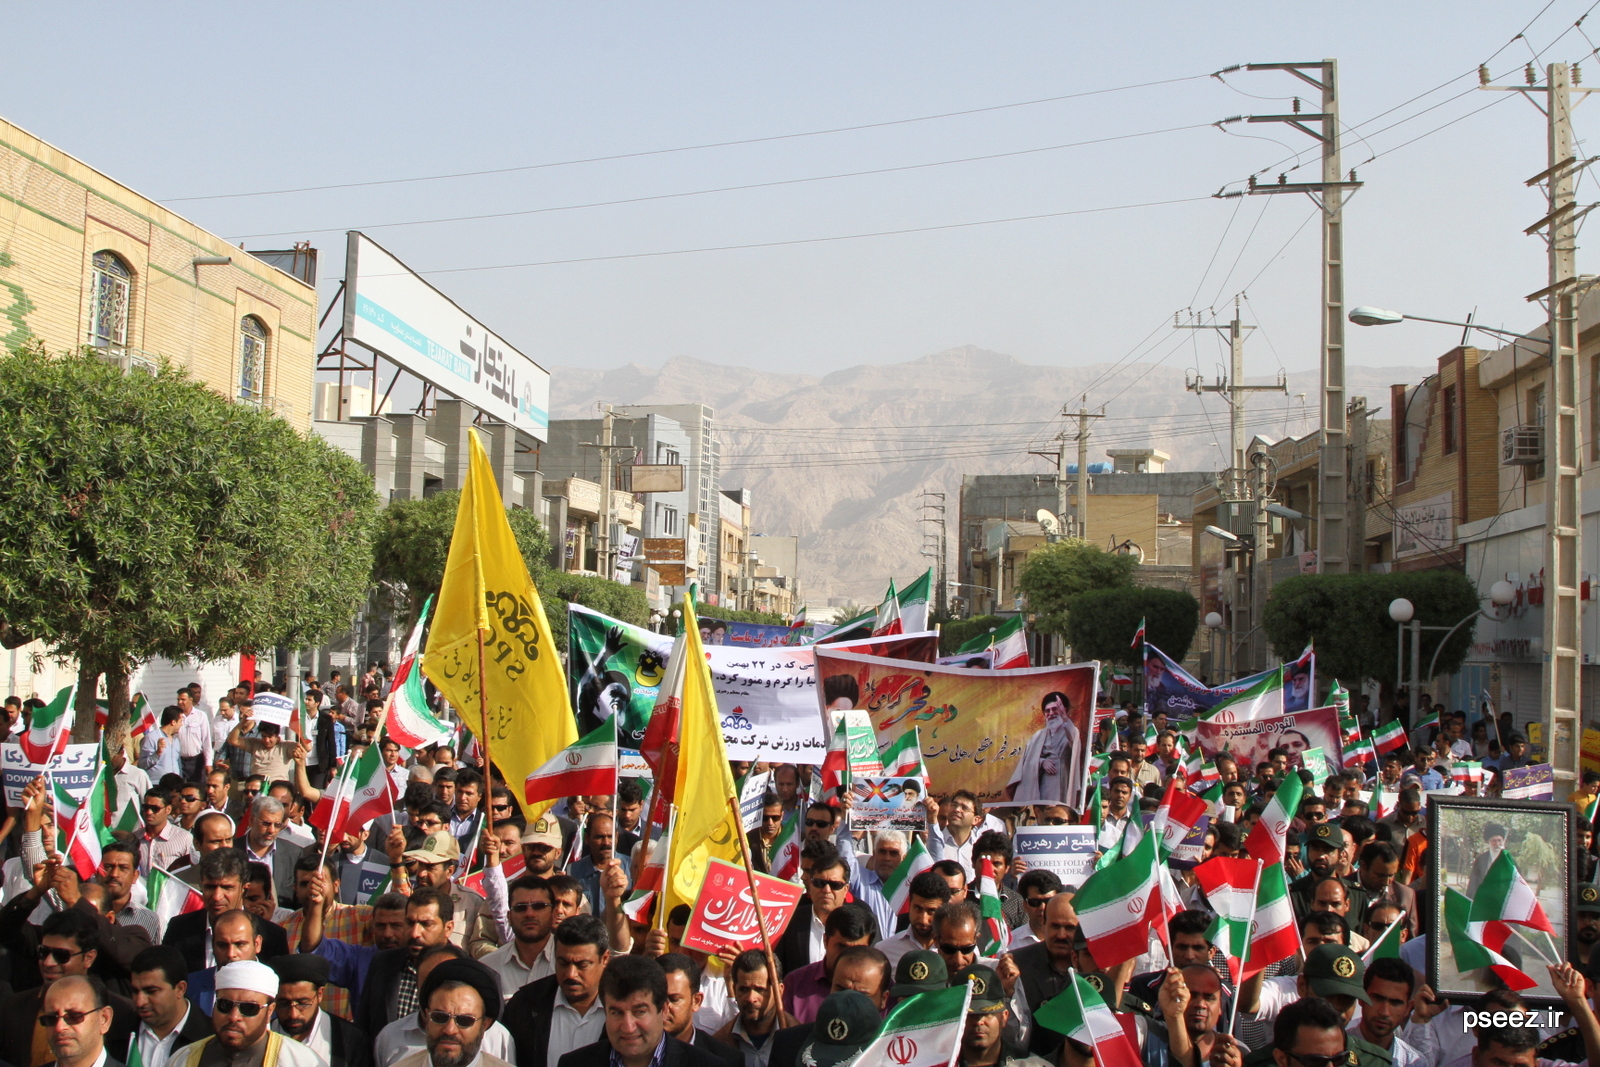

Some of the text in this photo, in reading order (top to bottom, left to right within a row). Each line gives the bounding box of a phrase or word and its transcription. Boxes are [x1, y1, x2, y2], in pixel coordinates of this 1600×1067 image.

[428, 338, 470, 381] TEJARAT BANK
[460, 324, 502, 392] تجارت
[752, 660, 766, 669] ۲۲
[770, 662, 782, 671] در
[784, 660, 796, 669] که
[764, 680, 771, 688] و
[740, 734, 770, 750] شرکت
[771, 736, 800, 752] ورزش
[922, 744, 948, 758] ملت
[1020, 835, 1096, 852] مطیع امر رهبریم
